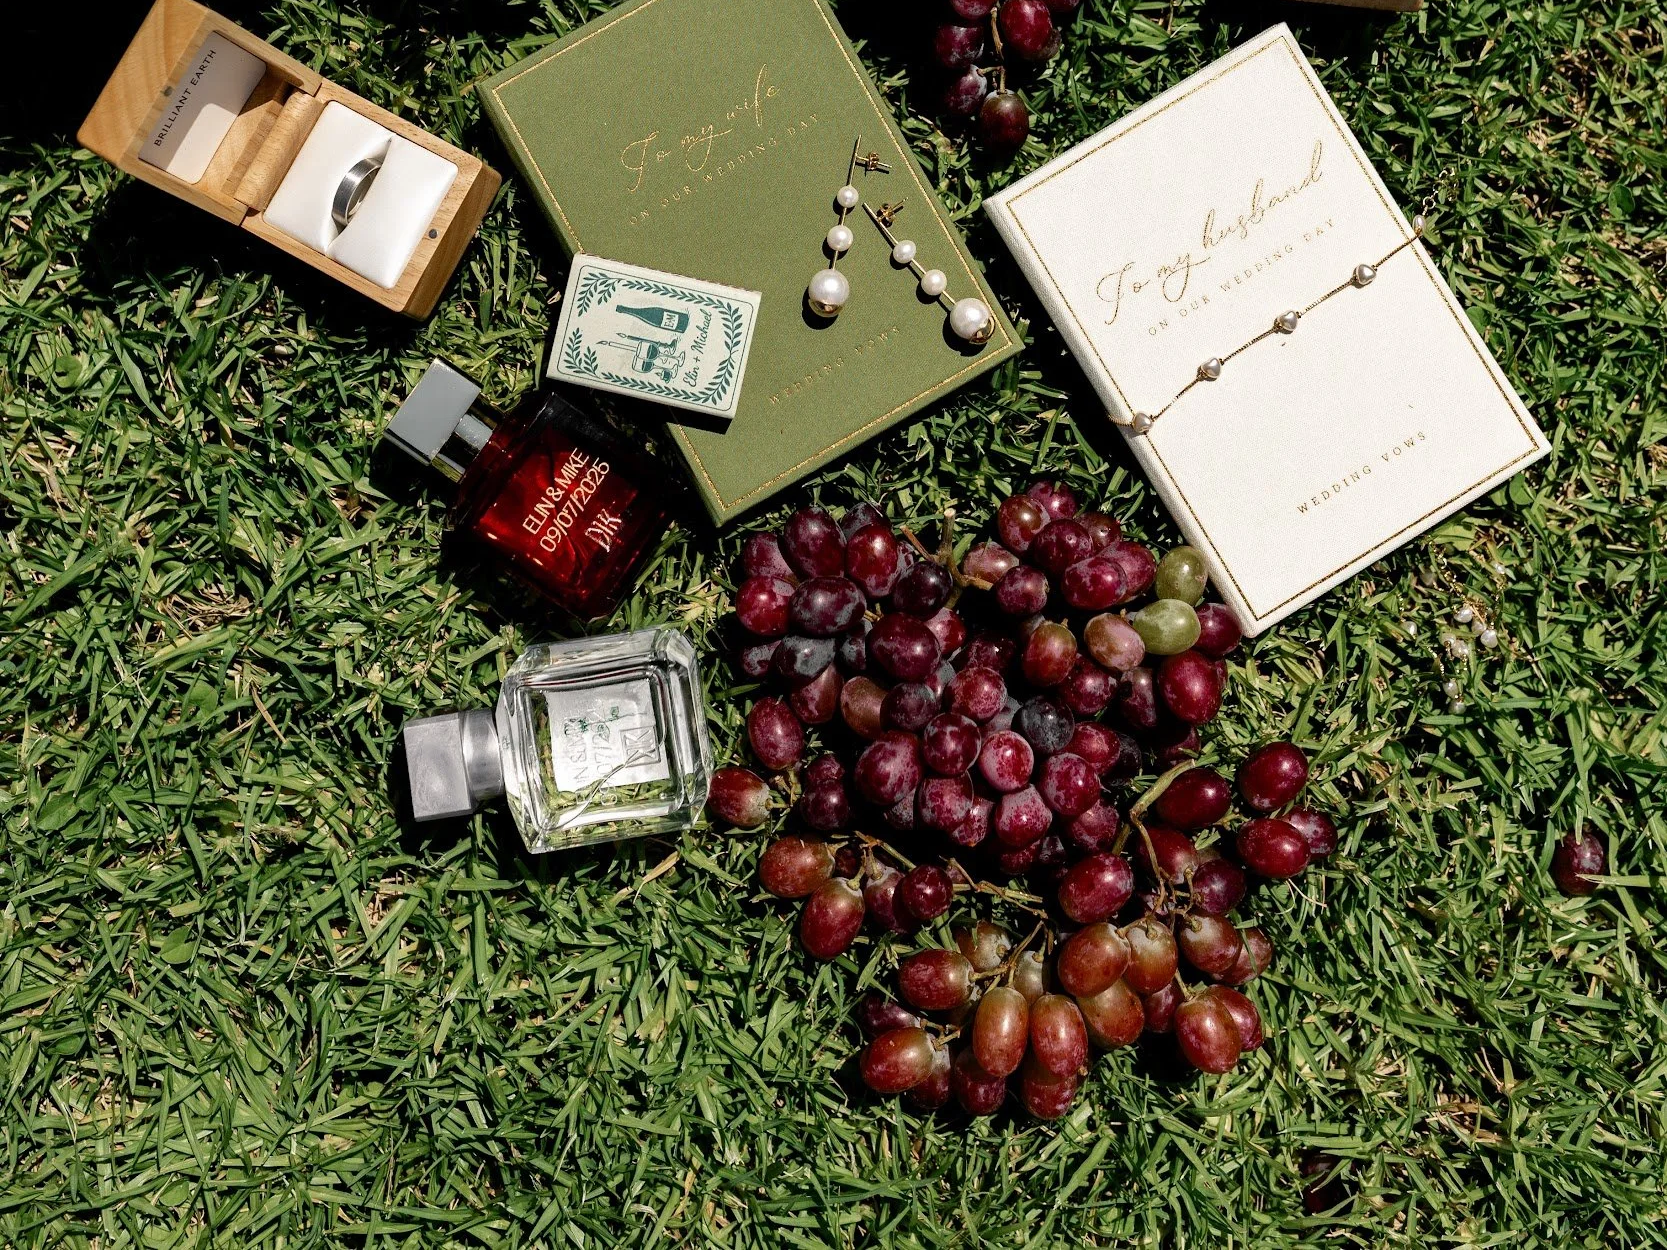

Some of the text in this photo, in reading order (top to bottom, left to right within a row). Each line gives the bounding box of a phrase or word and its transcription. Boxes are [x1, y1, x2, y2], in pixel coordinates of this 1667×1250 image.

[154, 49, 217, 147] BRILLIANT EARTH
[621, 63, 780, 192] To my wife
[630, 113, 818, 225] ON OUR WEDDING DAY
[1096, 139, 1323, 325] To my husband
[1148, 218, 1336, 336] ON OUR WEDDING DAY
[682, 366, 700, 388] Elin
[690, 308, 712, 355] Michael
[522, 447, 590, 535] ELIN & MIKE
[539, 456, 610, 553] 09/07/2025
[1296, 431, 1426, 514] WEDDING VOWS
